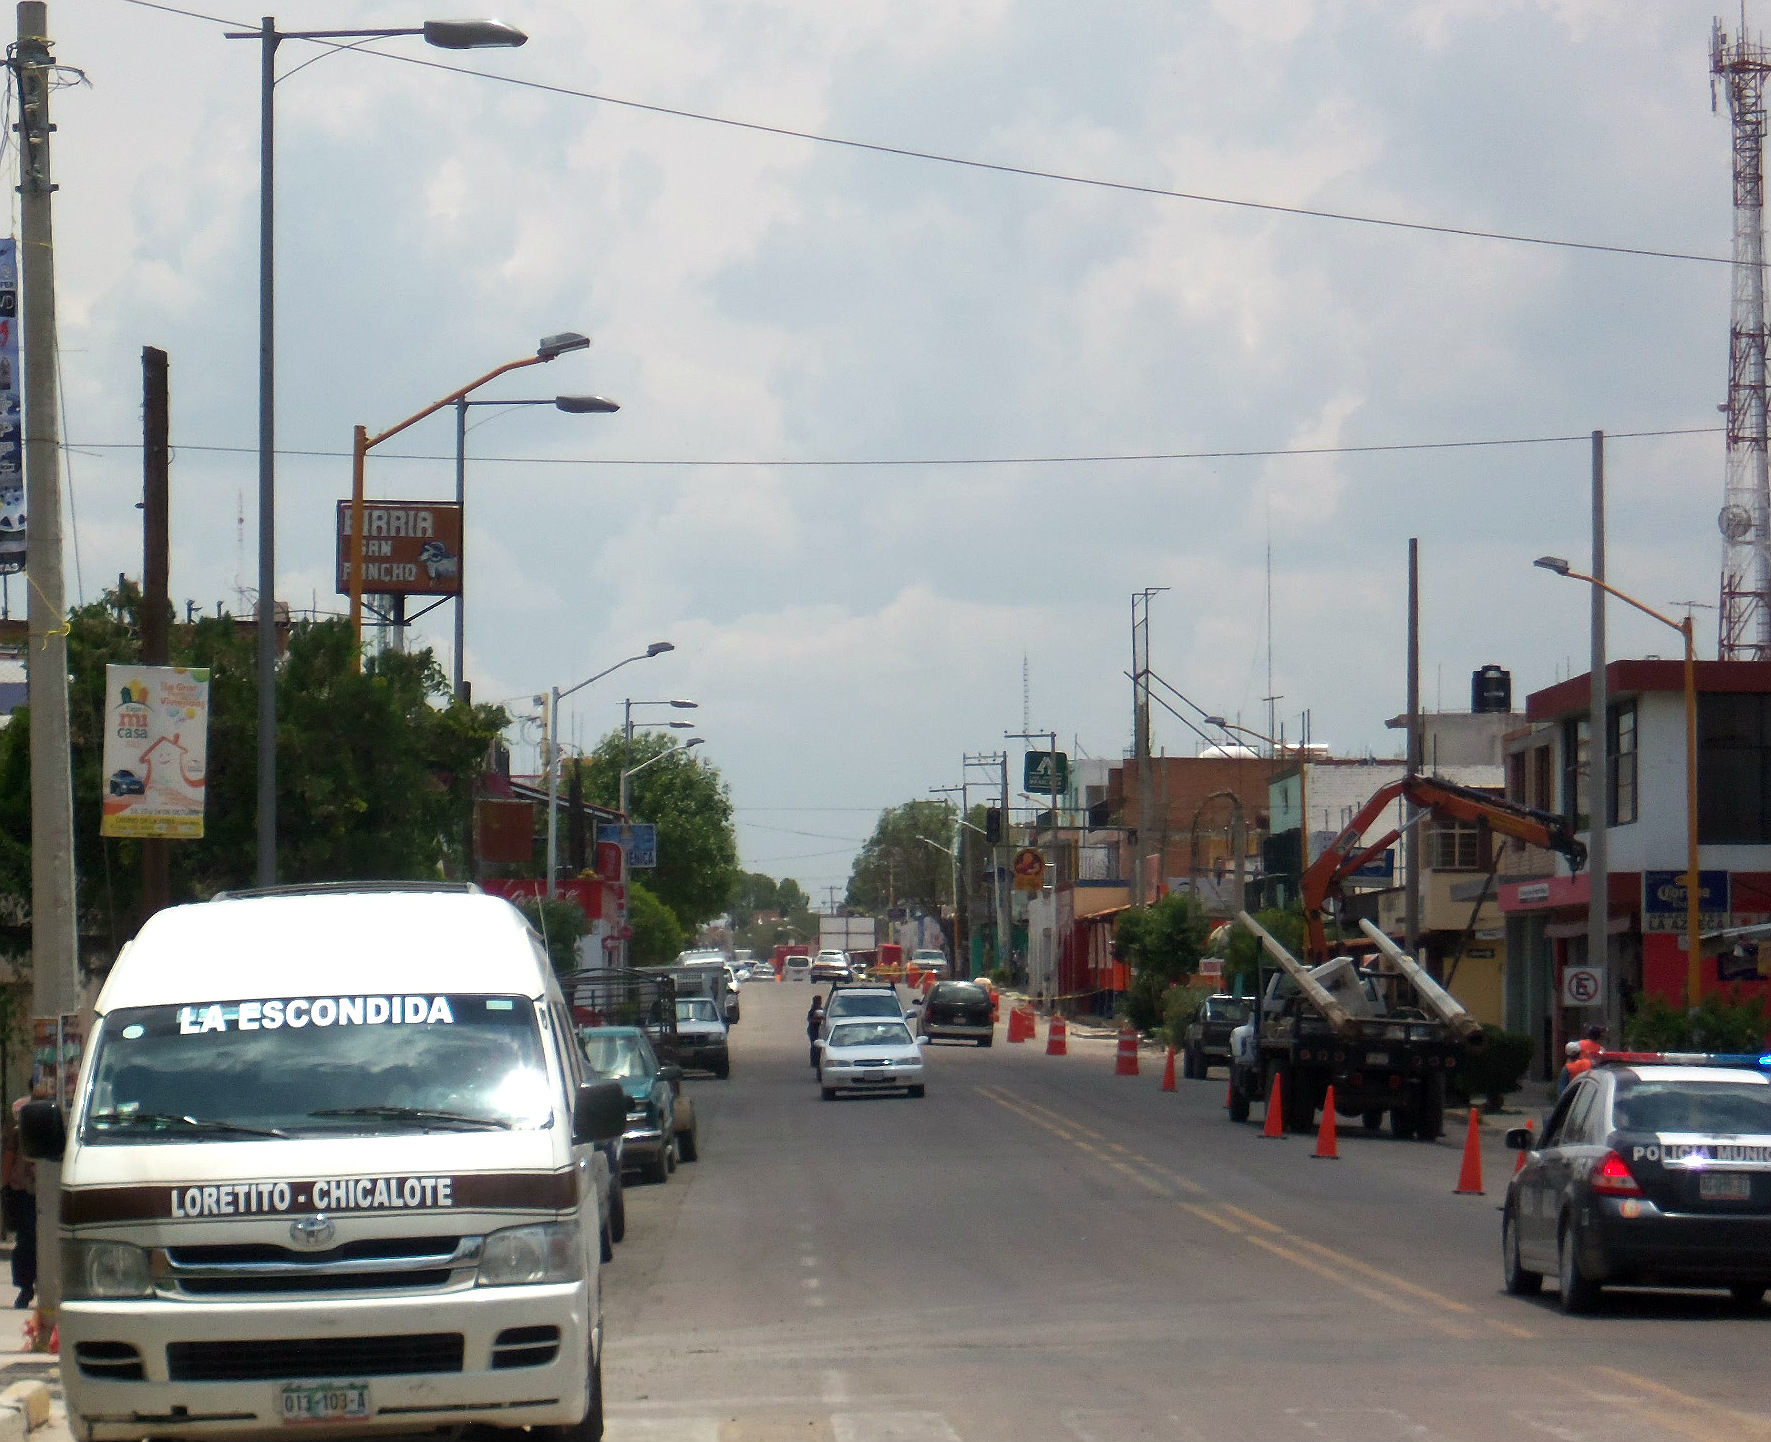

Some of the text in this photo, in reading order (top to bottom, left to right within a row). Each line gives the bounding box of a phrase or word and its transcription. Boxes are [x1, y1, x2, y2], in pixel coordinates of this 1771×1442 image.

[341, 562, 417, 581] PNCHO
[119, 713, 148, 727] mi
[117, 727, 148, 739] casa
[1657, 885, 1710, 901] Cora
[1671, 918, 1724, 931] AZECA
[1576, 977, 1590, 996] E
[180, 996, 454, 1035] LA ESCONDIDA
[1633, 1145, 1710, 1162] POLICIA
[171, 1182, 290, 1217] LORETITO
[313, 1178, 452, 1209] CHICALOTE
